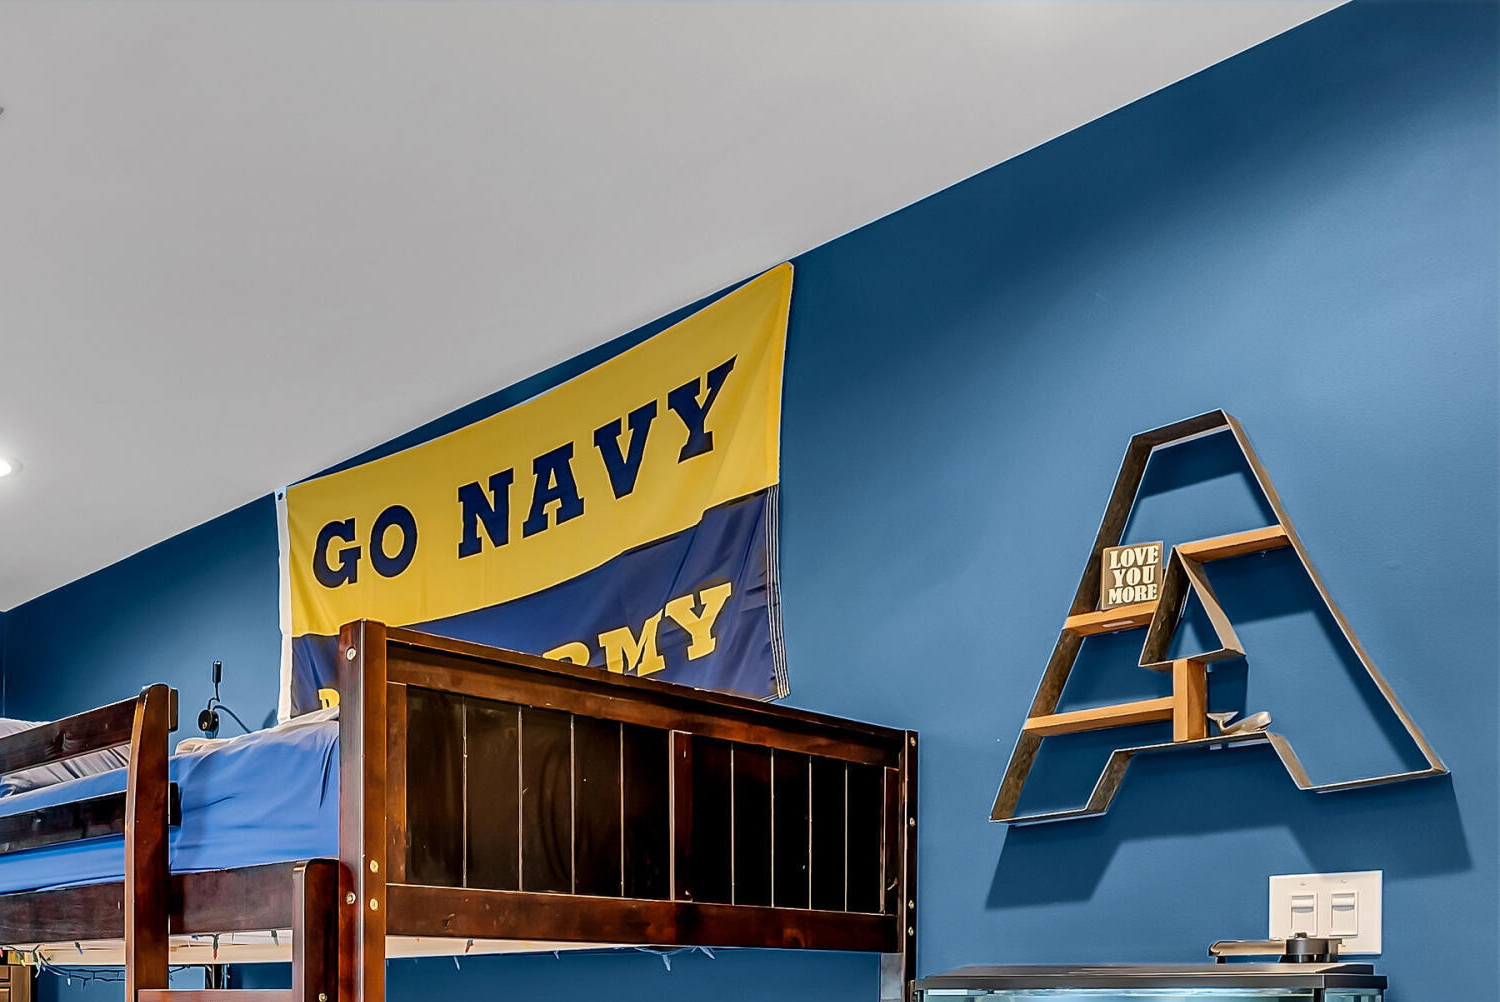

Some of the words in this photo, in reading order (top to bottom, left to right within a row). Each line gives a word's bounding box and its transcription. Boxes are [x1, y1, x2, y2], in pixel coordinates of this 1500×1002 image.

[311, 504, 418, 589] GO
[457, 354, 739, 560] NAVY
[1109, 545, 1159, 570] LOVE
[1112, 565, 1156, 588] YOU
[1108, 583, 1158, 605] MORE
[542, 582, 731, 677] MY
